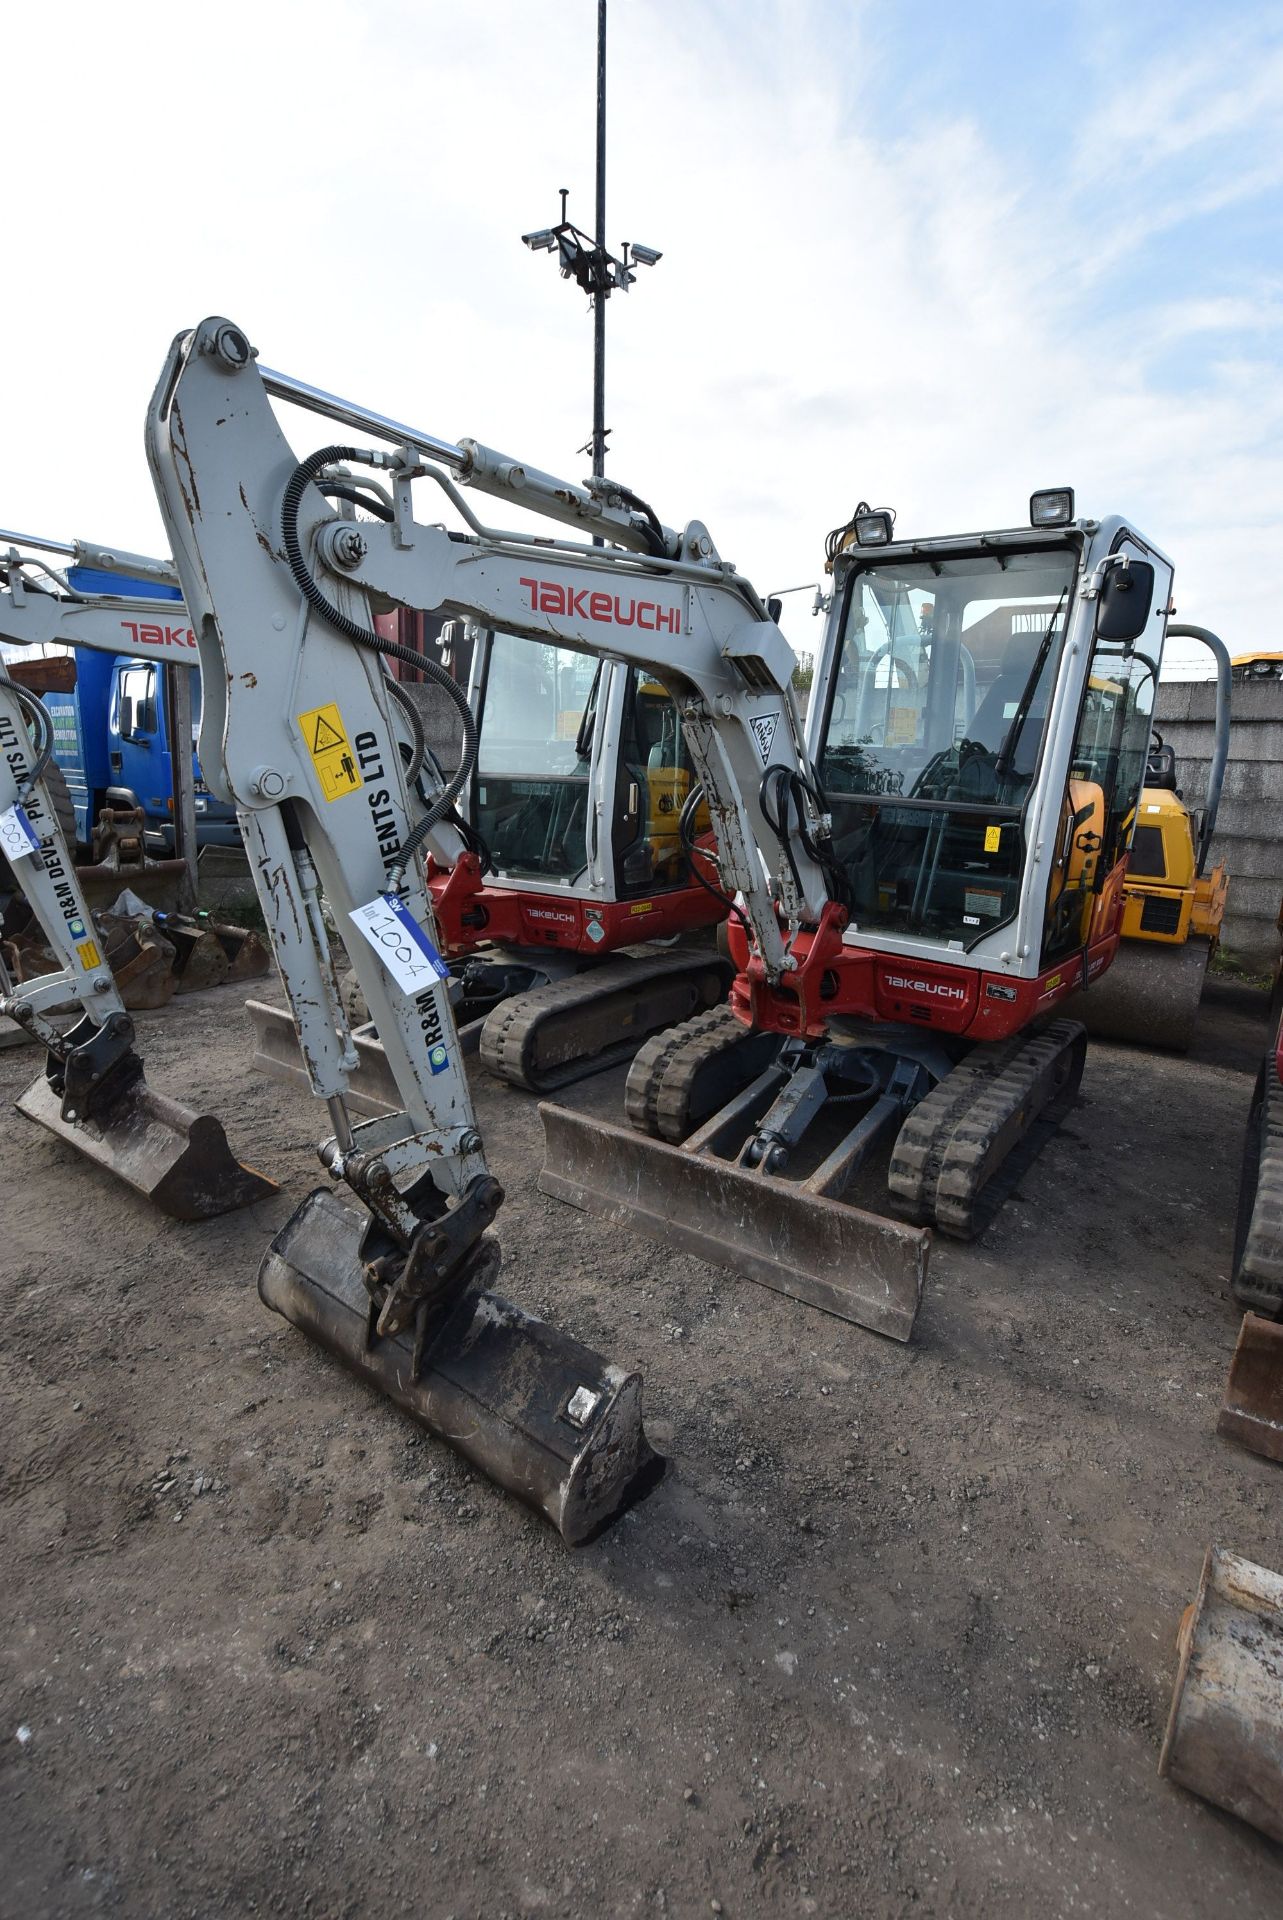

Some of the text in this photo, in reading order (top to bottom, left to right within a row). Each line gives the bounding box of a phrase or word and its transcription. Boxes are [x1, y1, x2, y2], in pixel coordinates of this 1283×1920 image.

[0, 716, 19, 749] LTD
[355, 731, 385, 783] LTD
[53, 881, 80, 921] R&M
[370, 916, 429, 977] 1004
[415, 989, 444, 1048] R&M
